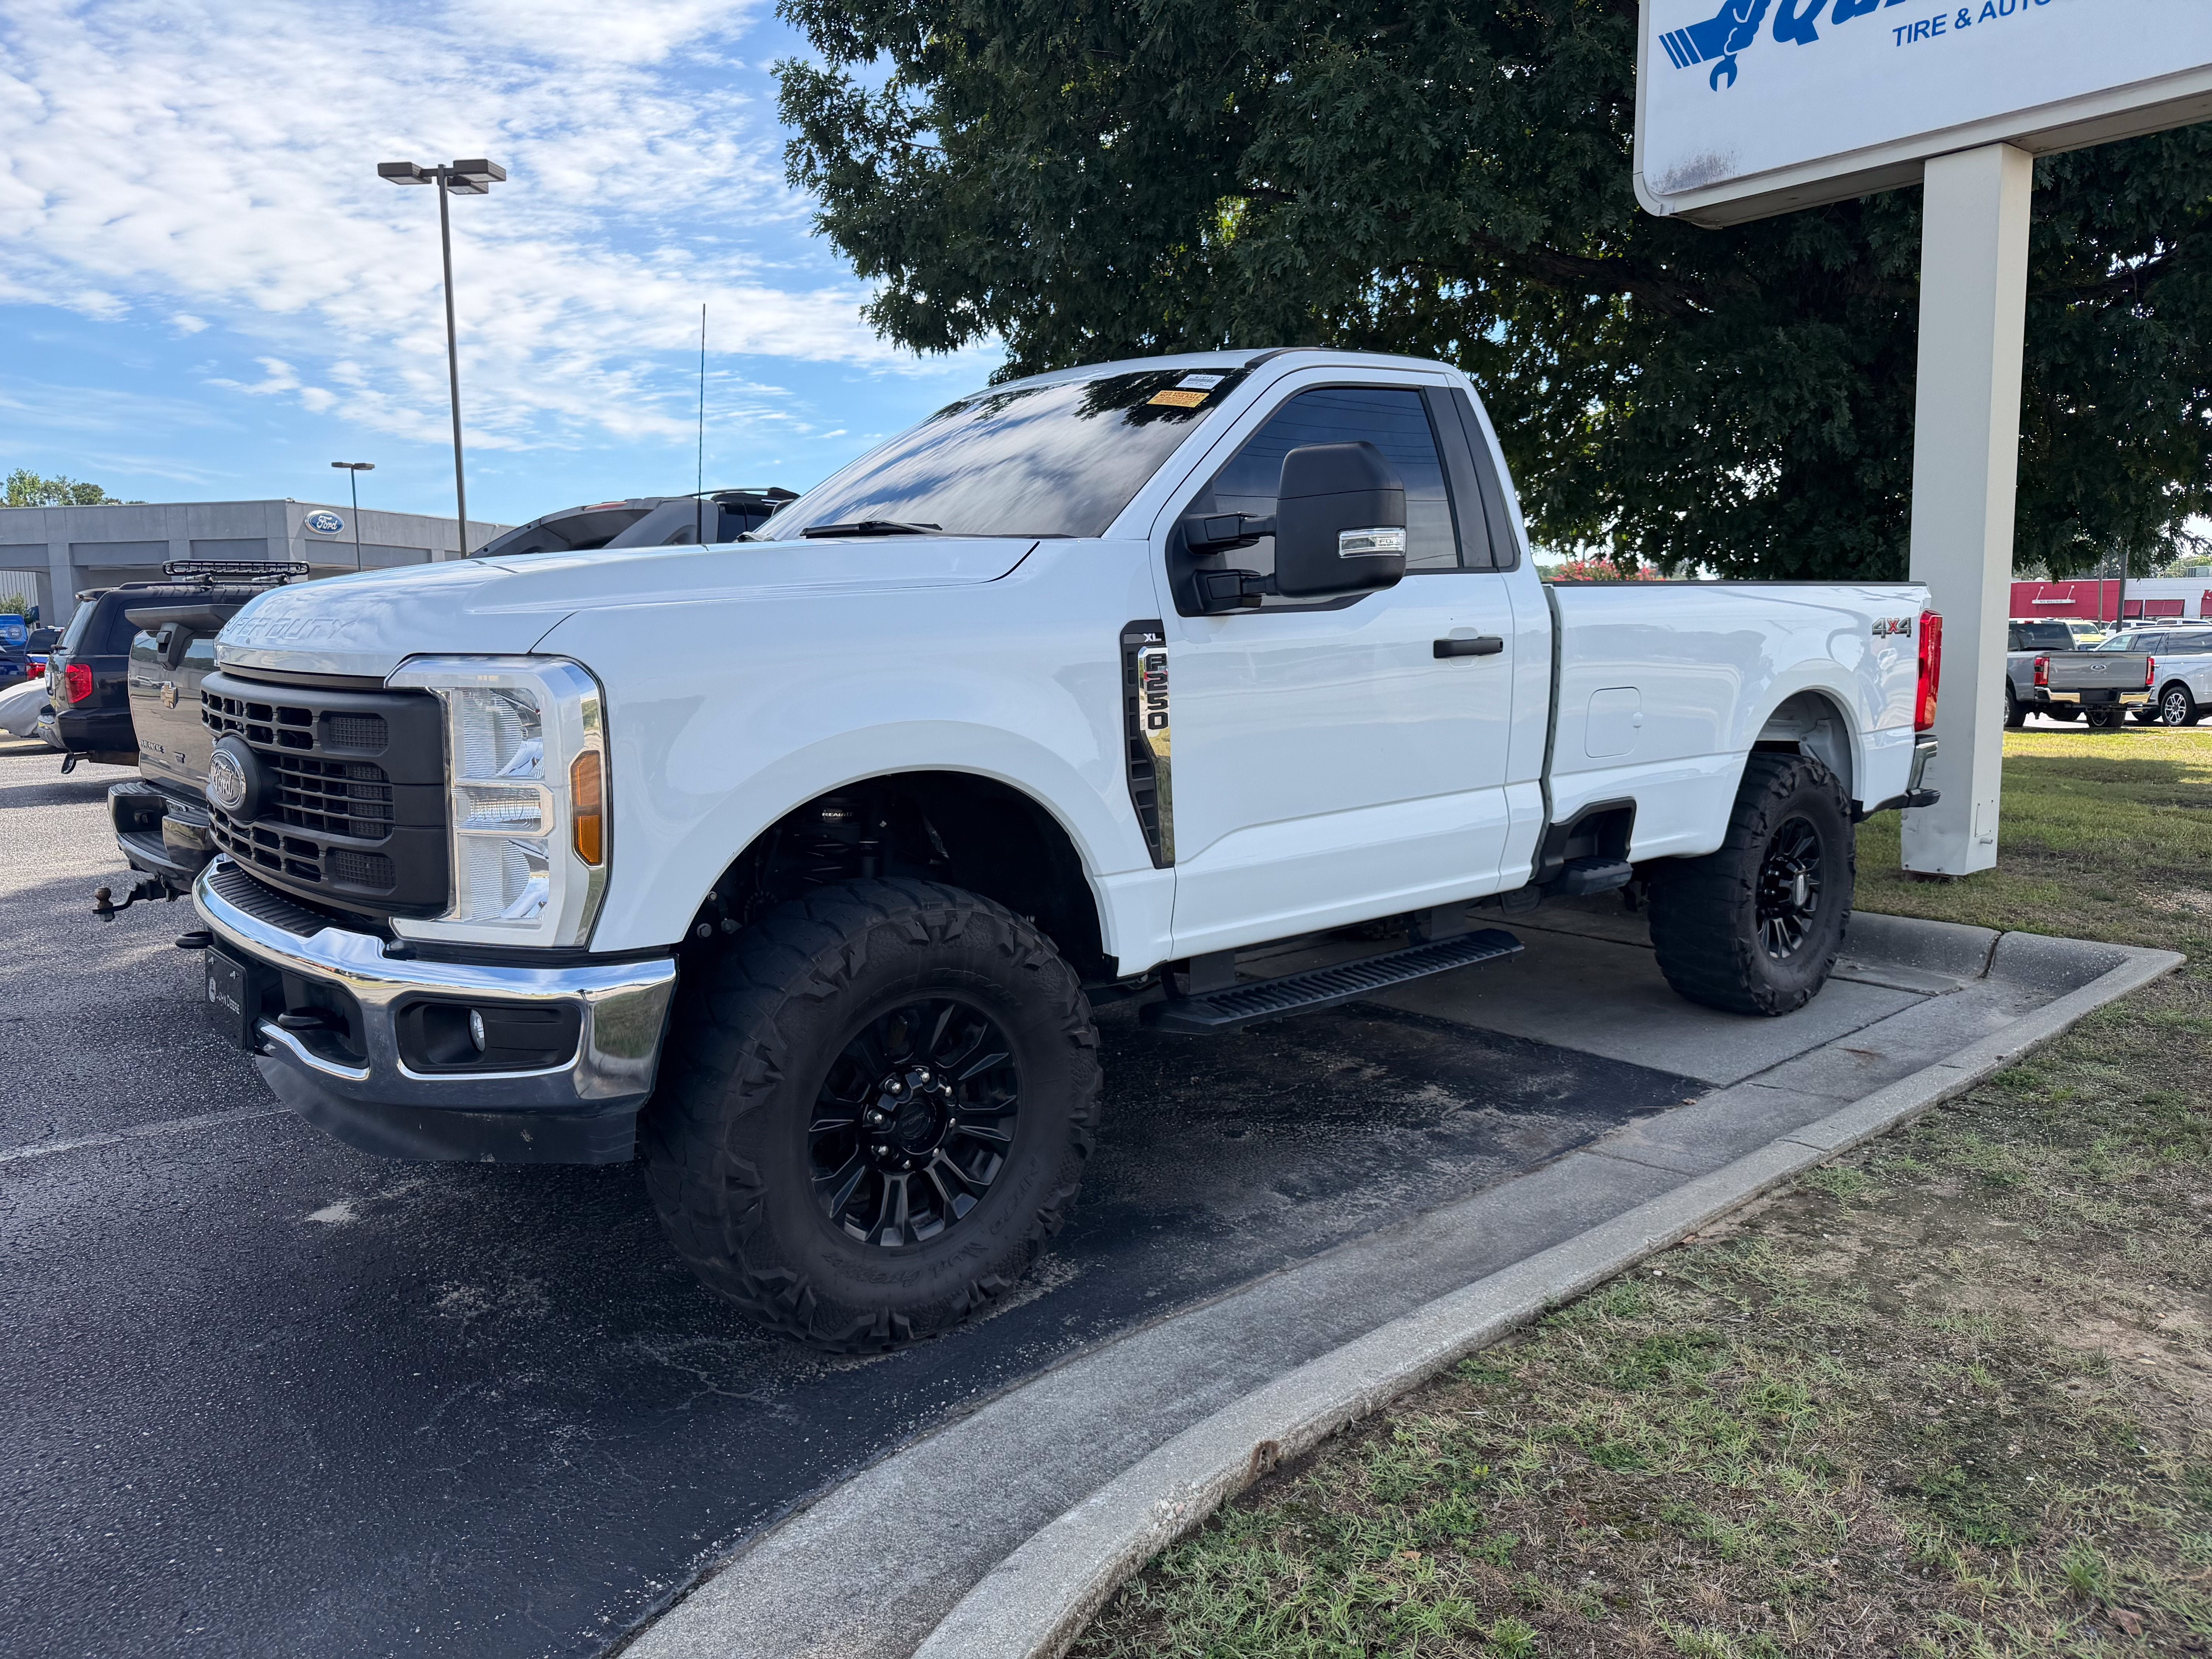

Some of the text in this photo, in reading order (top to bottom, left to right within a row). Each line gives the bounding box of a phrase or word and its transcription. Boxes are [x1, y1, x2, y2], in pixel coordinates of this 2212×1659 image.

[1893, 13, 1947, 47] TIRE
[1954, 8, 1972, 29] &
[1977, 0, 2052, 23] AU
[316, 515, 338, 530] Ford
[1143, 633, 1162, 642] XL
[1146, 653, 1169, 730] F250
[213, 759, 234, 797] Ford
